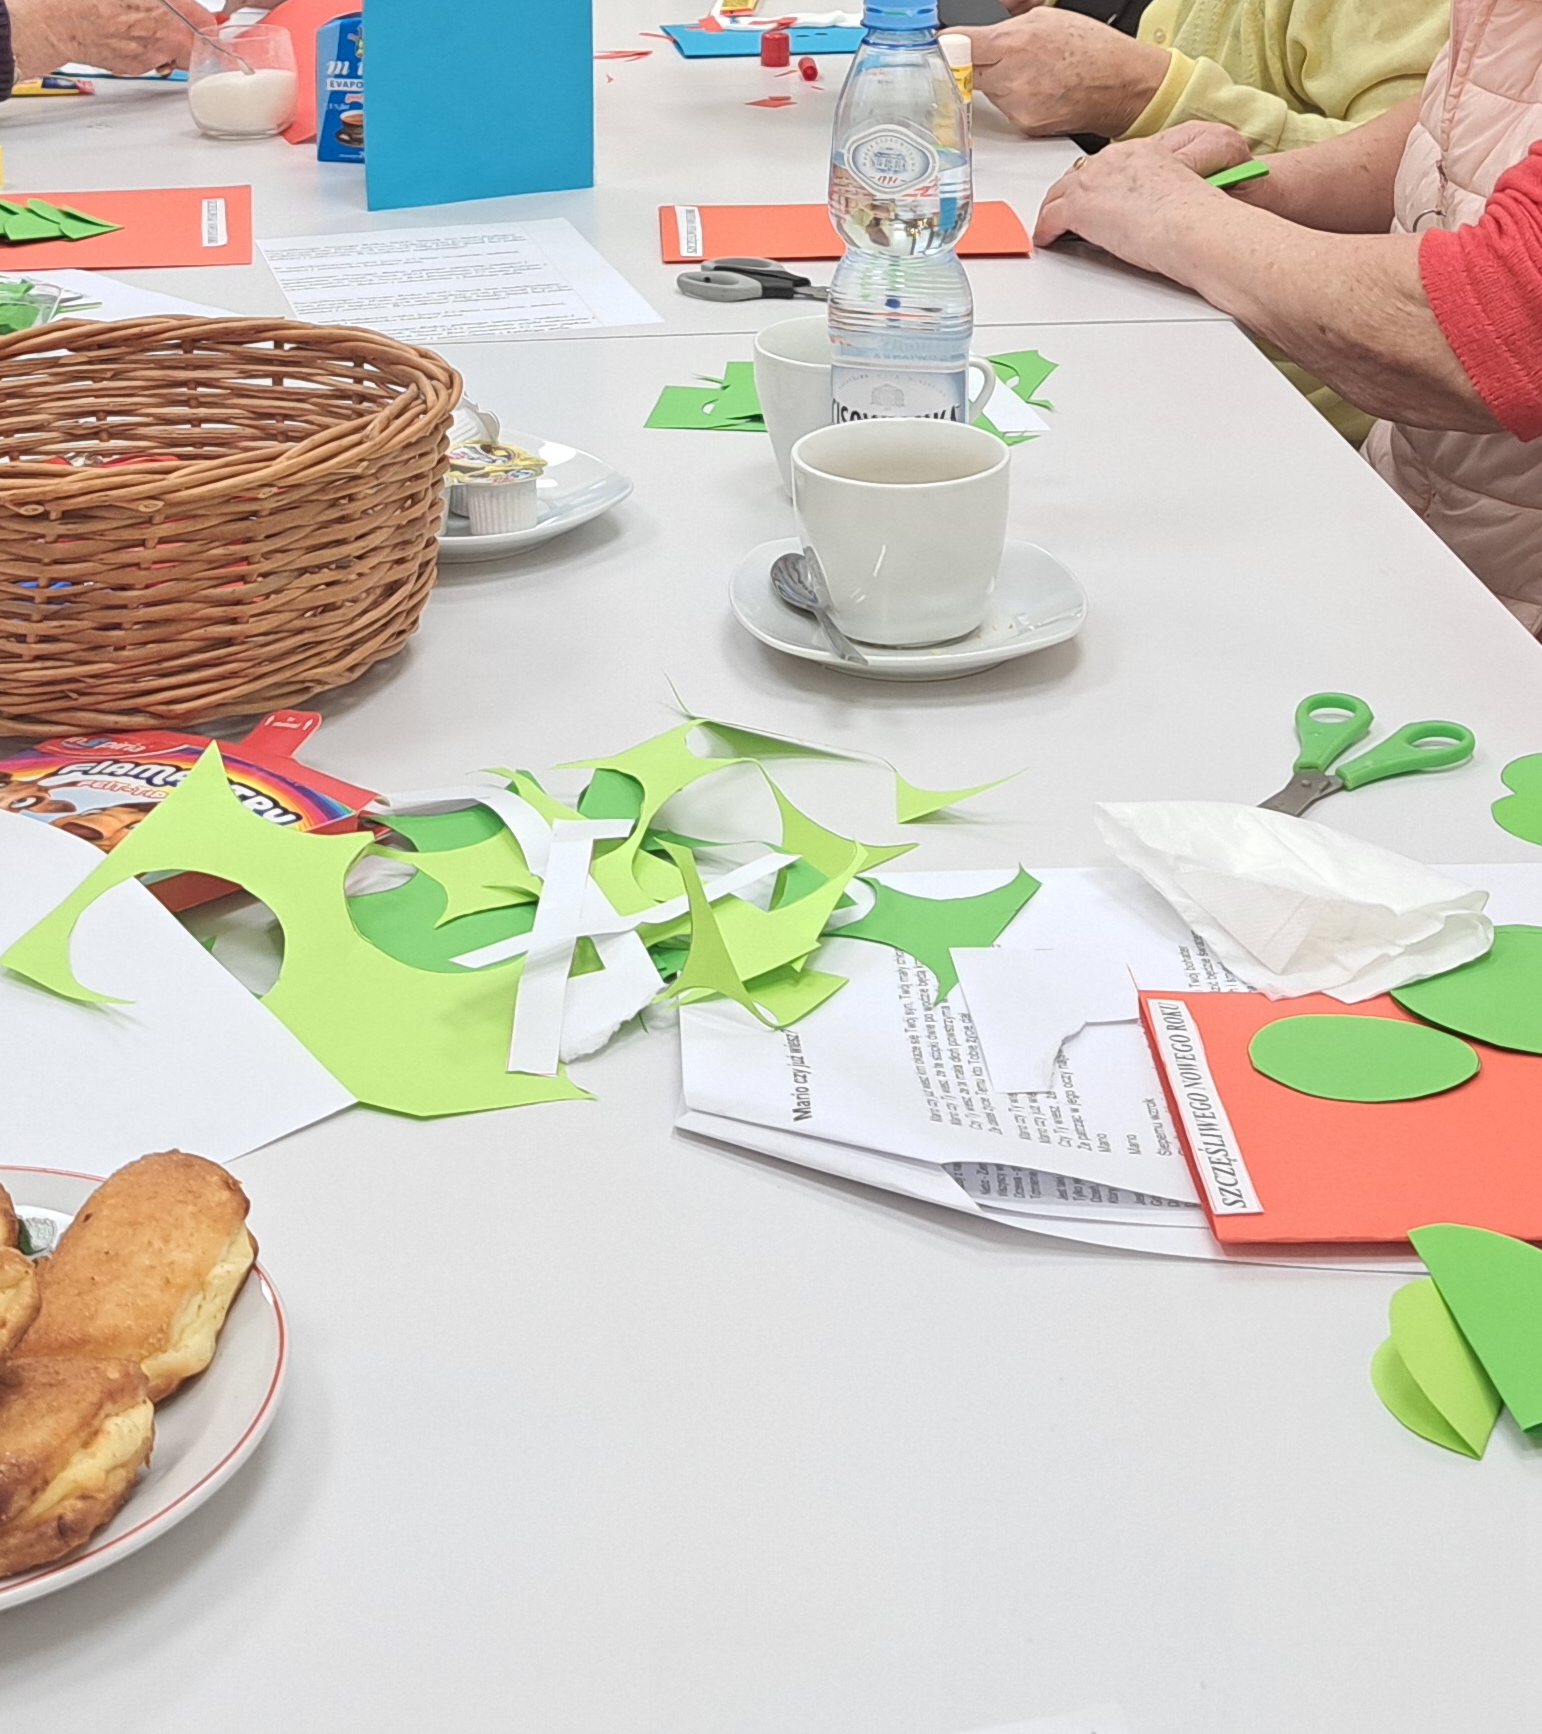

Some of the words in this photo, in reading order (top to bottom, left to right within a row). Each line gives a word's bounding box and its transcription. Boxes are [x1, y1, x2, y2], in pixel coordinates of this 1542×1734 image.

[1163, 1002, 1187, 1031] ROKU
[1176, 1034, 1200, 1090] NOWEGO
[791, 1086, 812, 1122] Mario
[1186, 1092, 1247, 1208] SZCZĘŚLIWEGO
